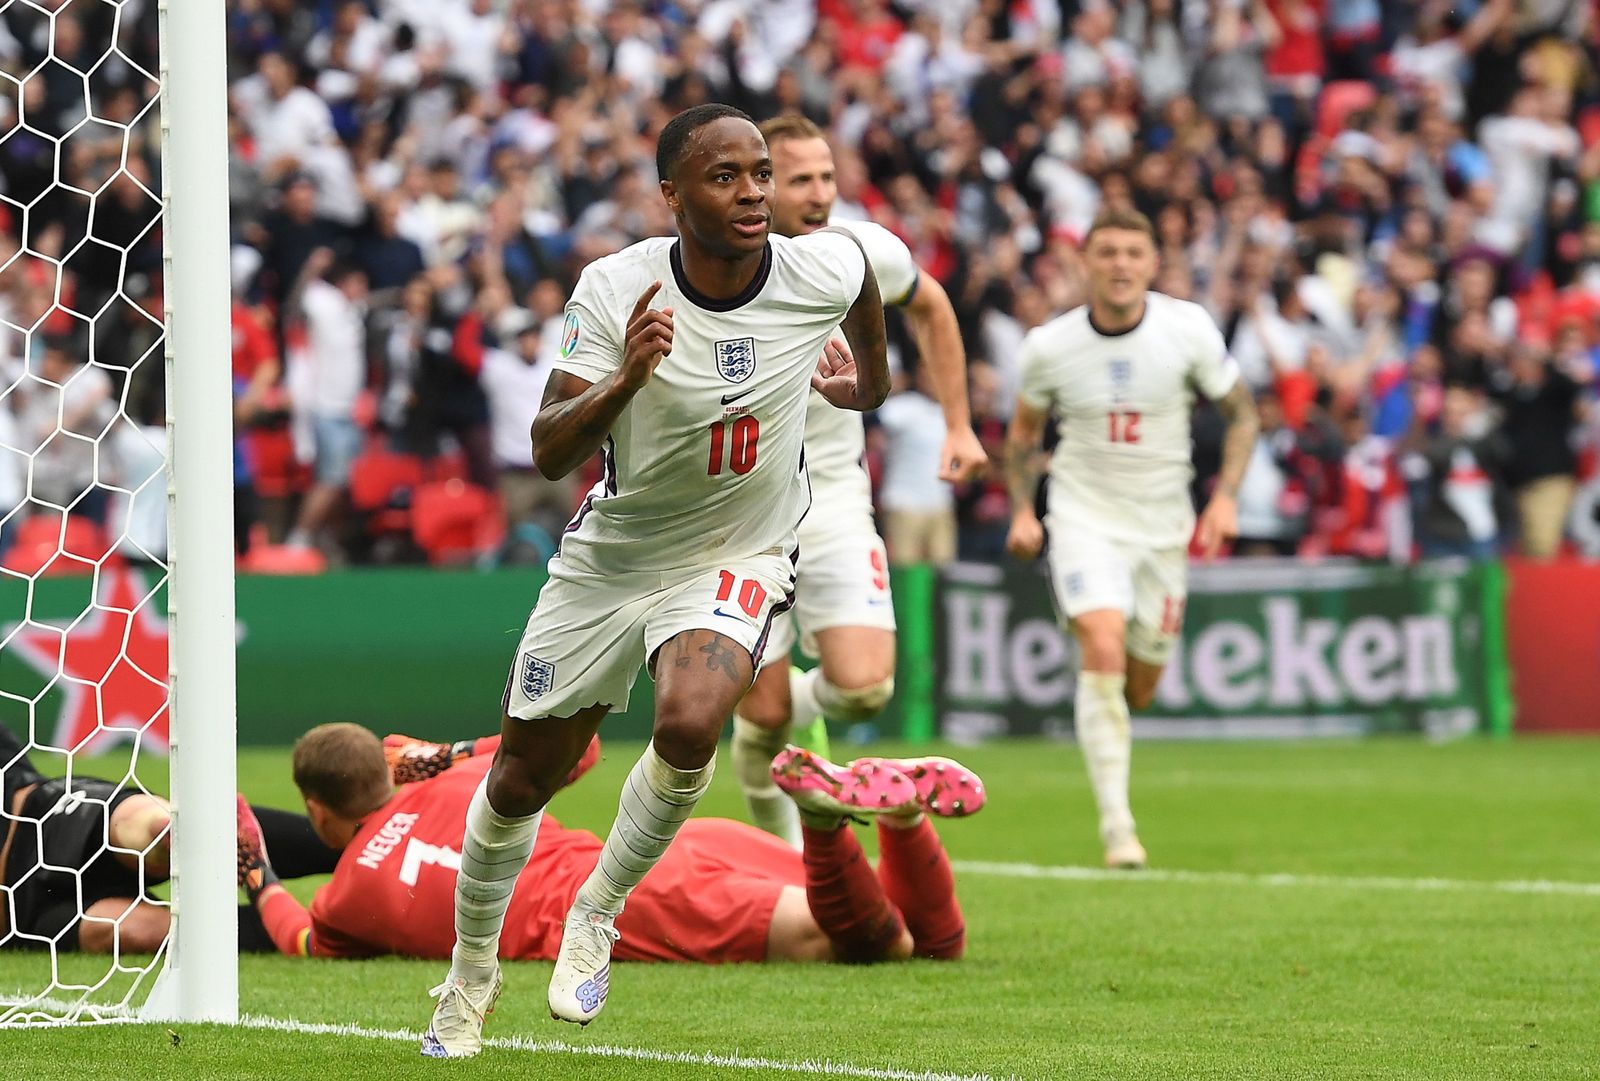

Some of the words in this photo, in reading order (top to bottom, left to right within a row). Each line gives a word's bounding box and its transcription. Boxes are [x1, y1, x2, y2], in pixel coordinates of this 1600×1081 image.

[708, 415, 760, 476] 10
[1108, 411, 1142, 444] 12
[716, 569, 767, 619] 10
[943, 592, 1461, 710] Heeken
[356, 812, 419, 870] NEUER
